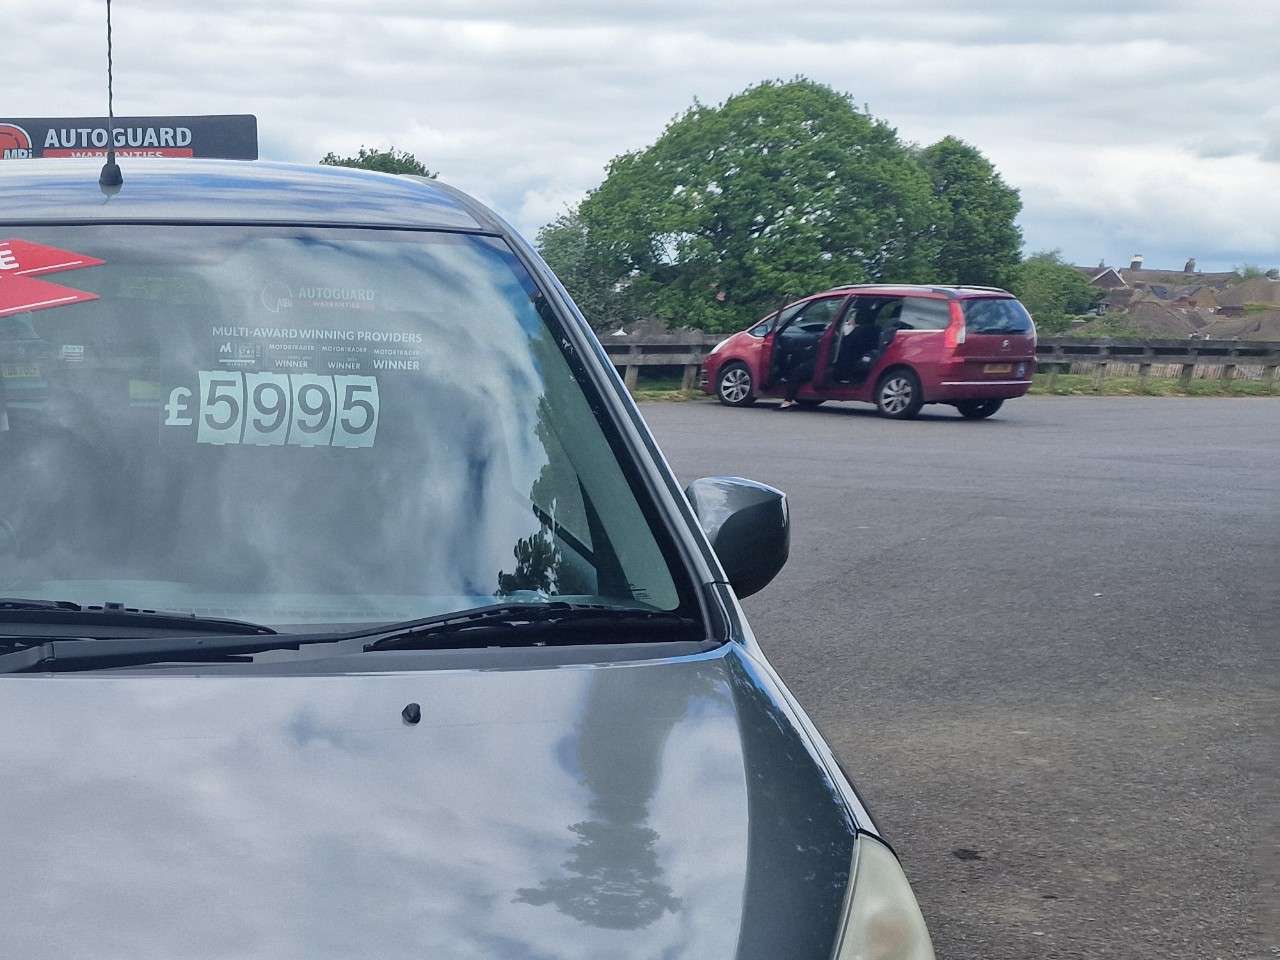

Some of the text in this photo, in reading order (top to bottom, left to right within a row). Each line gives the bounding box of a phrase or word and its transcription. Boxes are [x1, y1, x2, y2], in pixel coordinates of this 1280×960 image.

[44, 127, 192, 148] AUTOGUARD
[299, 287, 376, 300] AUTOGUARD
[212, 326, 423, 343] MULTI-AWARD WINNING PROVIDERS
[274, 359, 308, 368] WINNER
[327, 361, 361, 370] WINNER
[373, 359, 420, 370] WINNER
